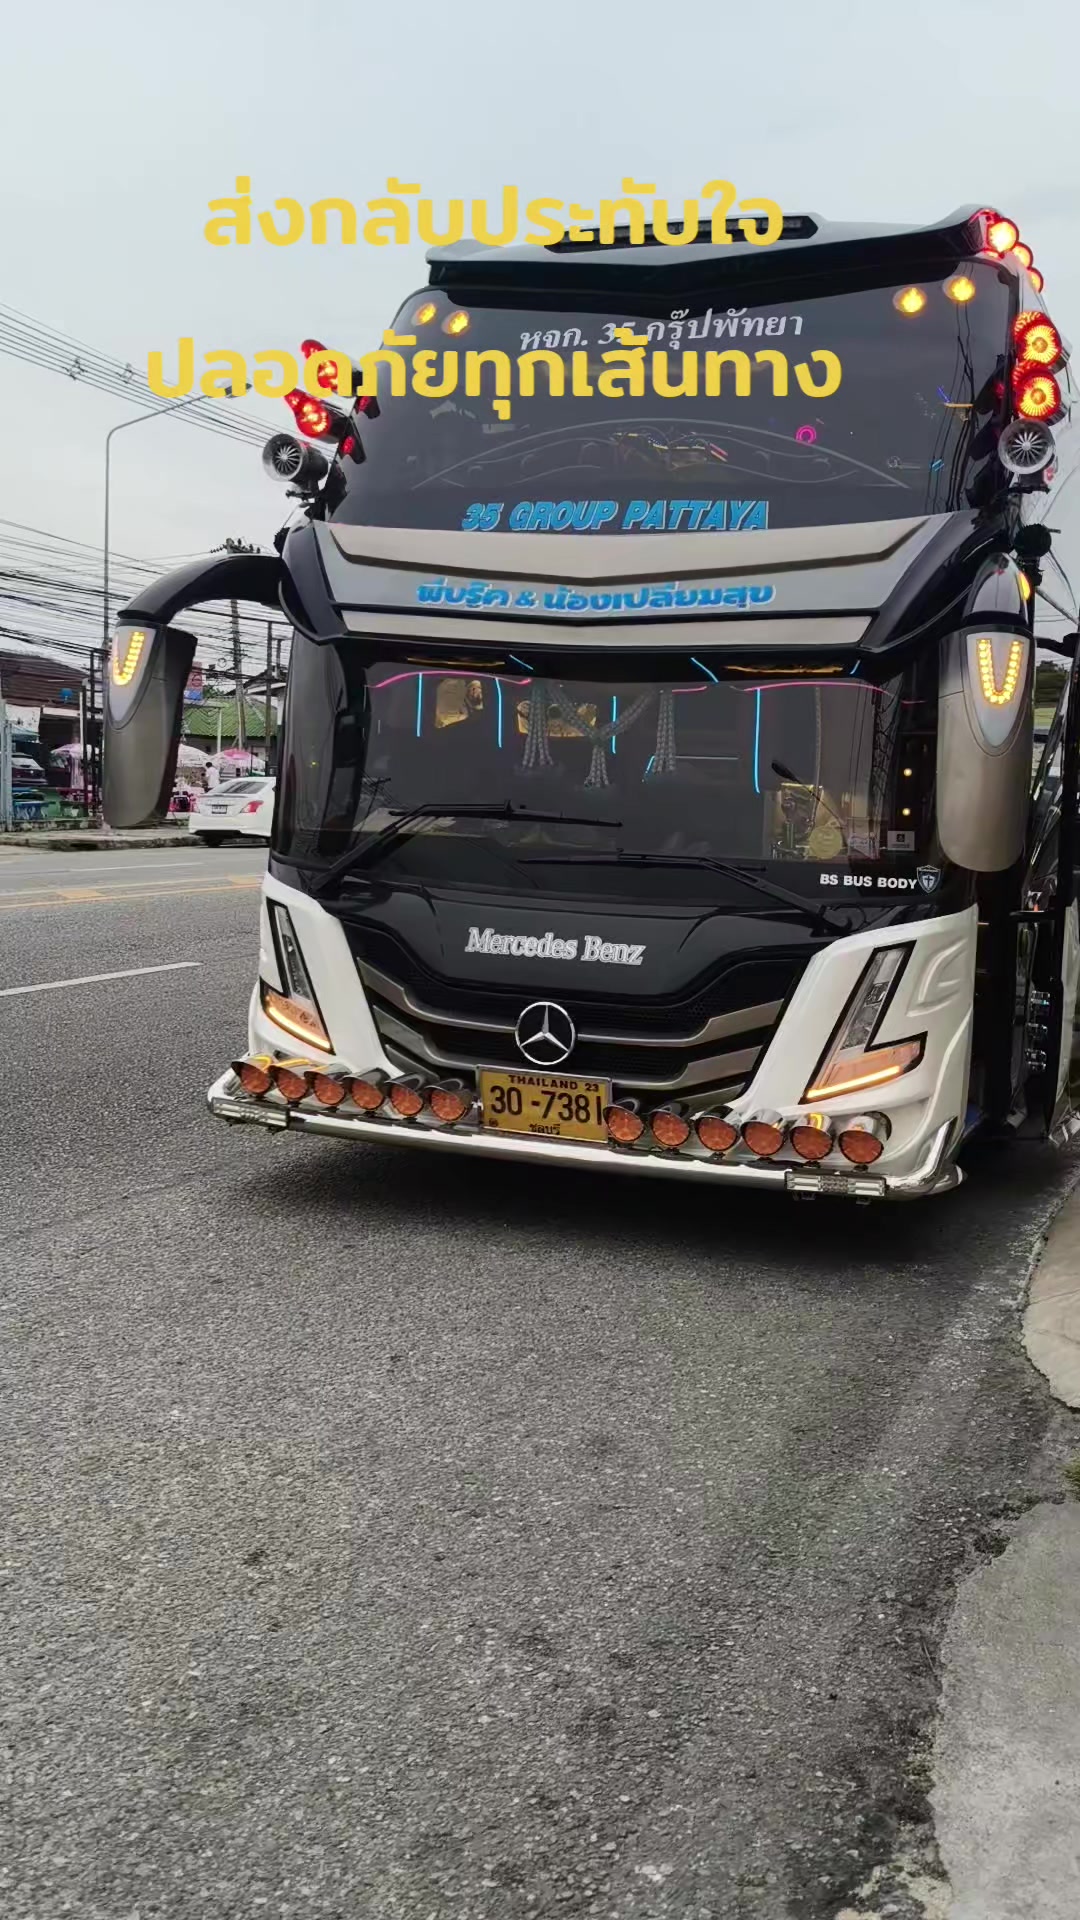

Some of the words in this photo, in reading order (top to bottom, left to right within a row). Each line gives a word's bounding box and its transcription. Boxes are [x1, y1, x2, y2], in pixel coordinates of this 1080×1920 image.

[520, 327, 588, 350] หจก.
[647, 307, 803, 350] กรุ๊ปพัทยา
[461, 503, 503, 531] 35
[508, 500, 617, 531] GROUP
[621, 500, 770, 531] PATTAYA
[515, 590, 539, 608] &
[820, 873, 839, 886] BS
[843, 875, 872, 887] BUS
[877, 877, 918, 889] BODY
[465, 926, 578, 959] Mercedes
[581, 934, 646, 965] Benz
[508, 1074, 578, 1090] THAILAND
[584, 1082, 599, 1092] 23
